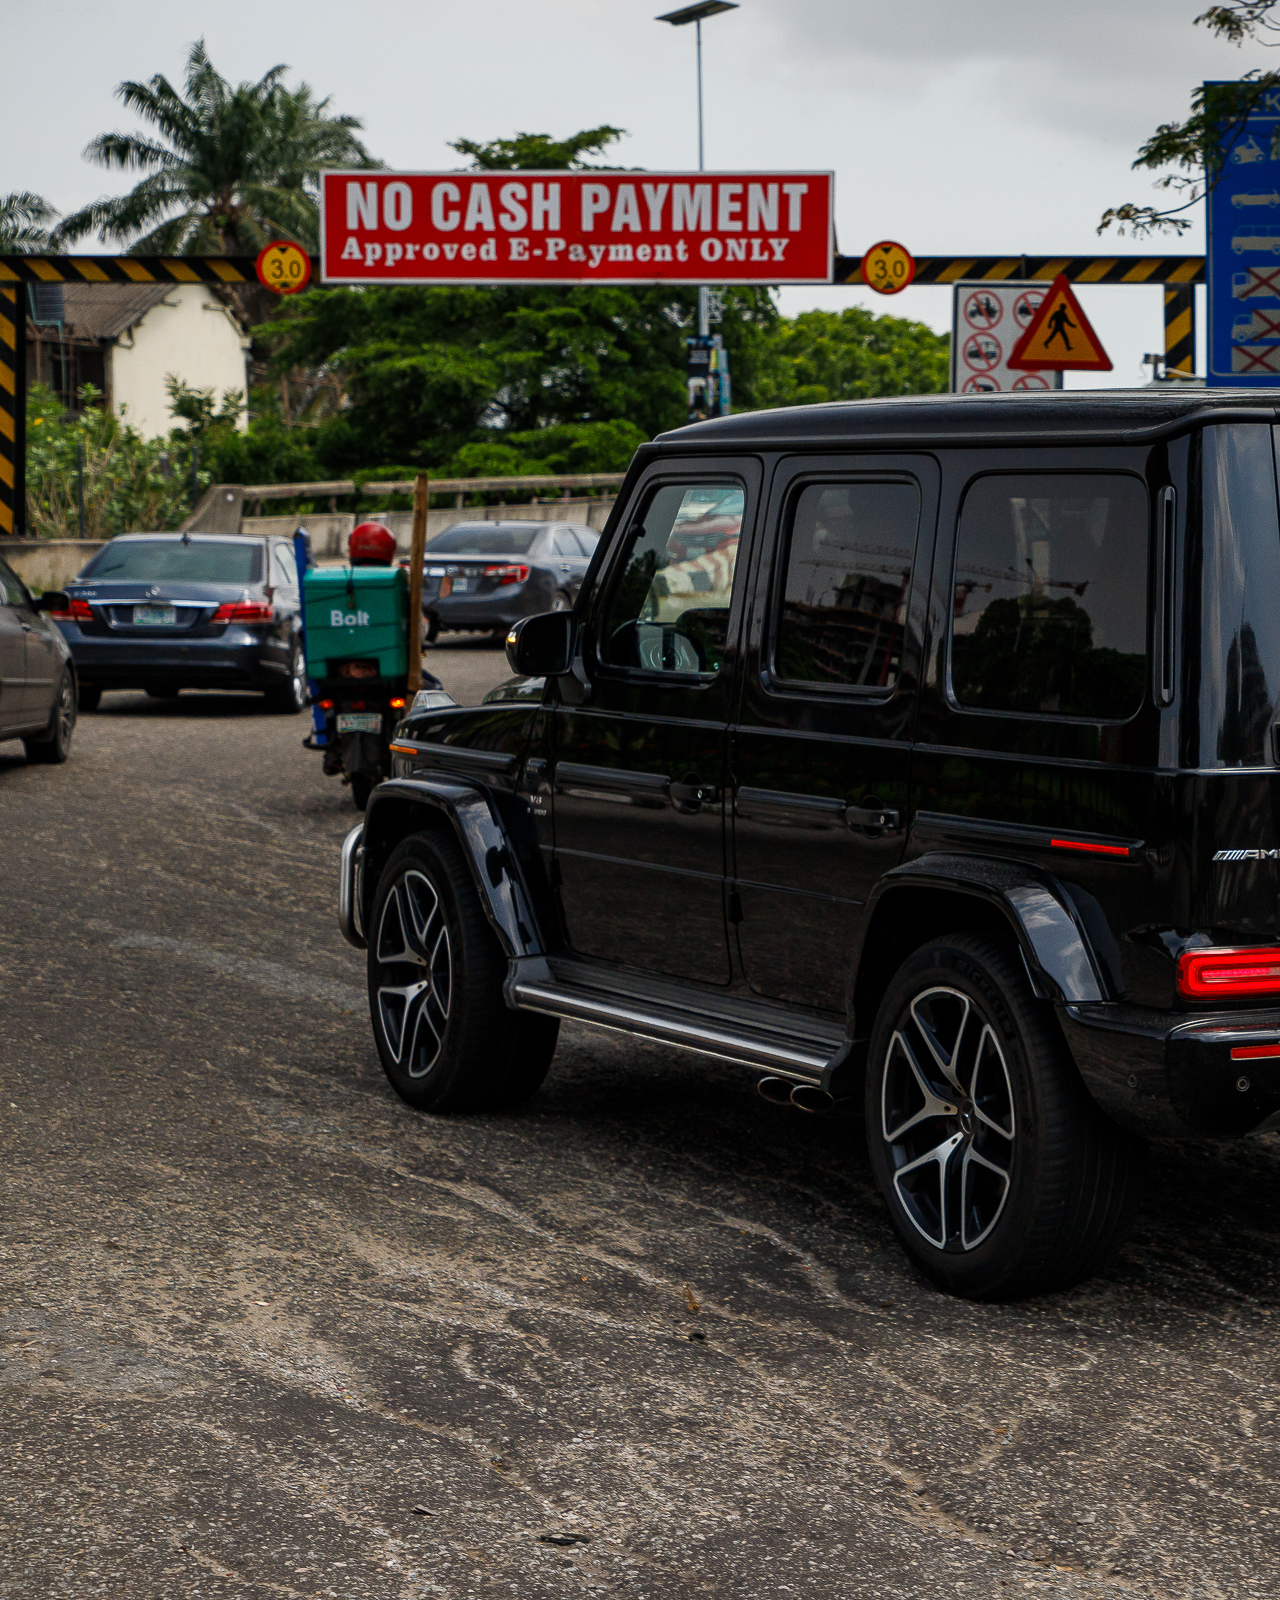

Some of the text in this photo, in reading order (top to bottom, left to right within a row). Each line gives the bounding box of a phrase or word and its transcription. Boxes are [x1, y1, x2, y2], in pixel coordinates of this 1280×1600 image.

[346, 182, 808, 233] NO CASH PAYMENT
[341, 236, 790, 268] Approved E-Payment ONLY
[330, 609, 370, 627] Bolt
